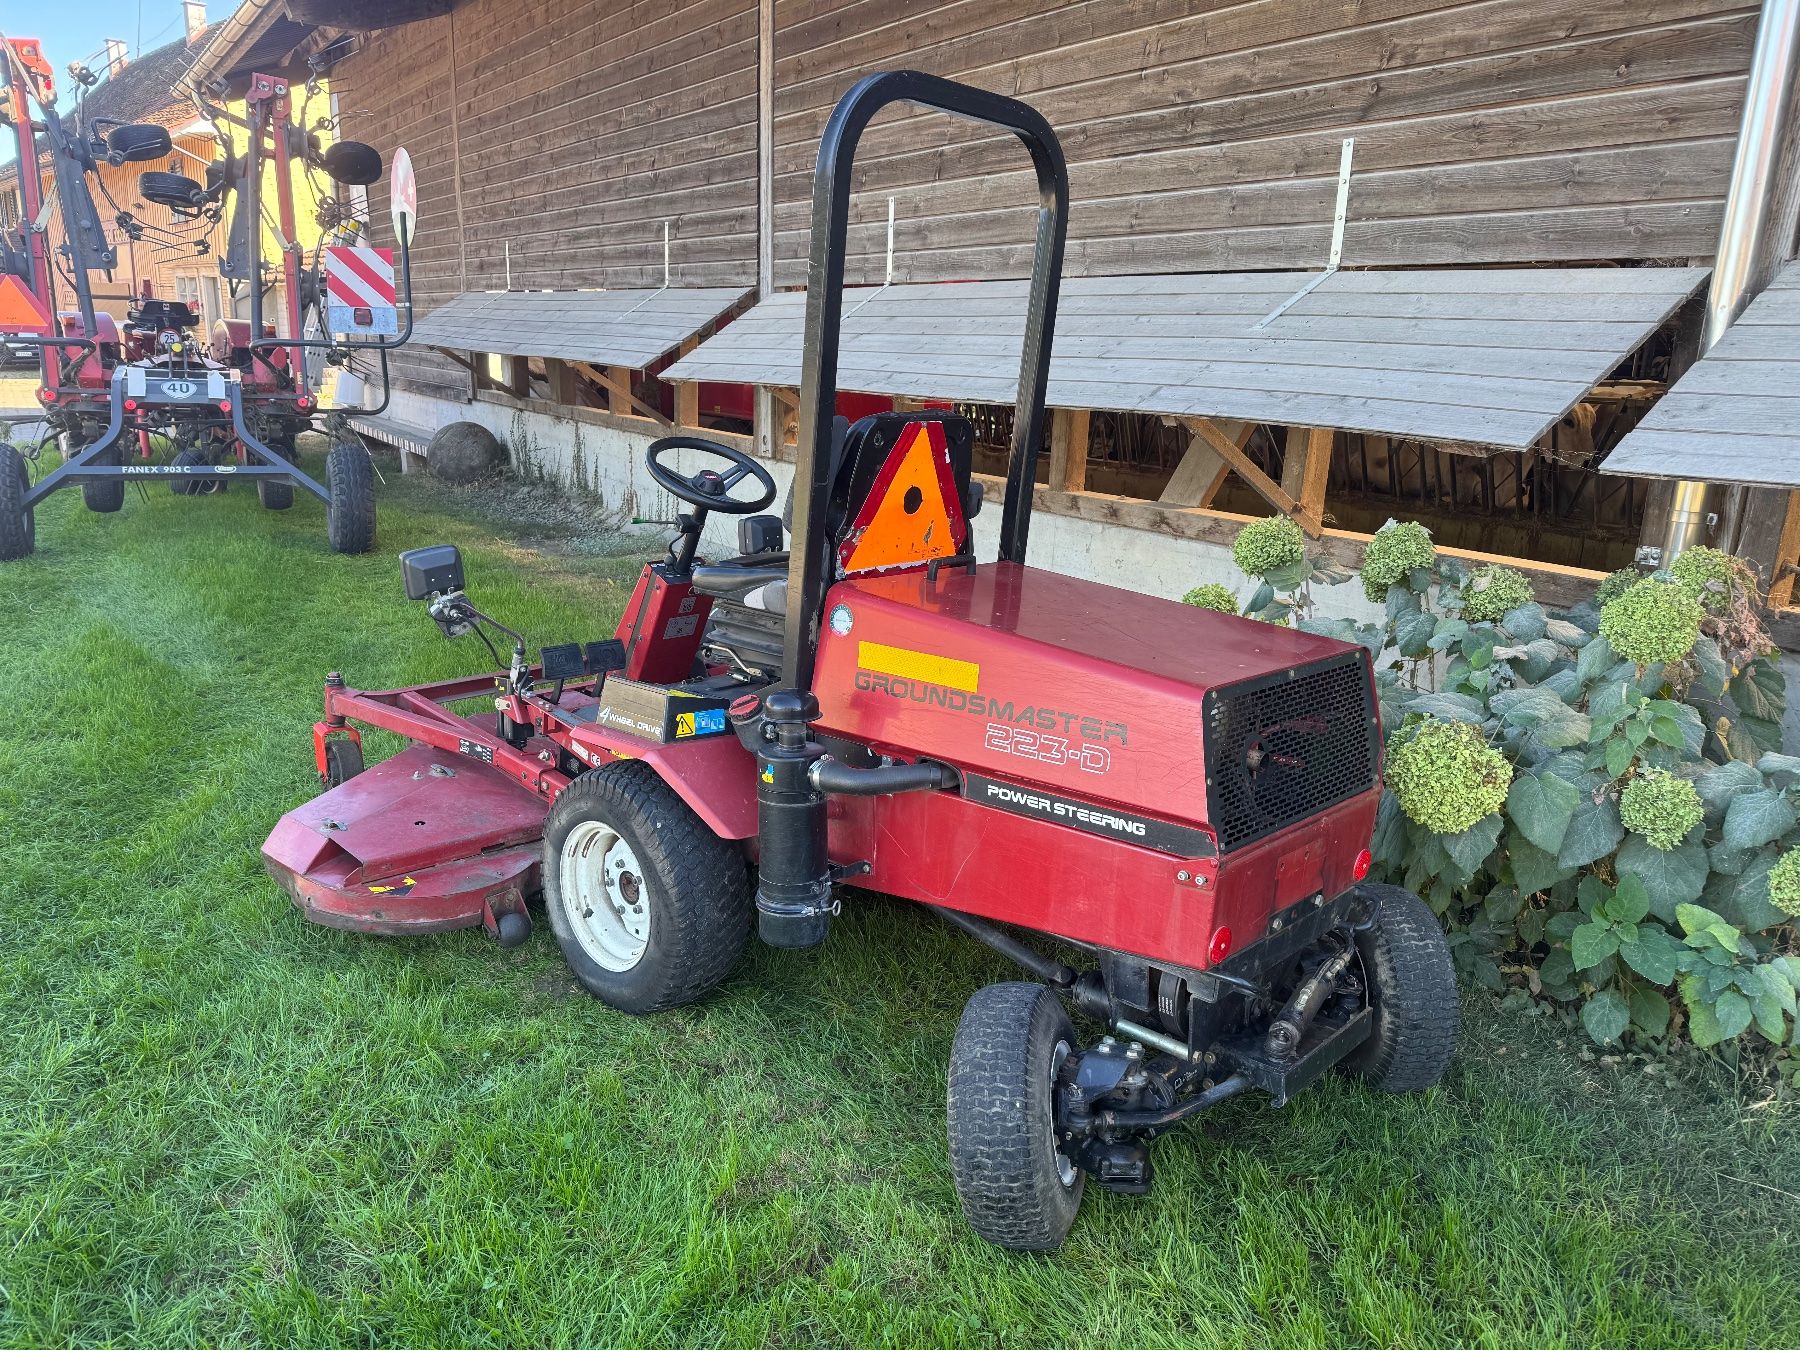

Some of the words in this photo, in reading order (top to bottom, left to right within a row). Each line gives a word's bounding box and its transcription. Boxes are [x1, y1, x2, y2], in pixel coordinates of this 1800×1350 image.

[164, 334, 175, 344] 25
[599, 706, 611, 724] 4
[609, 712, 637, 728] WHEEL
[637, 722, 662, 736] DRIVE
[854, 671, 1128, 745] GROUNDSMASTER
[985, 722, 1111, 774] 223-D
[987, 785, 1051, 812] POWER
[1053, 803, 1146, 836] STEERING
